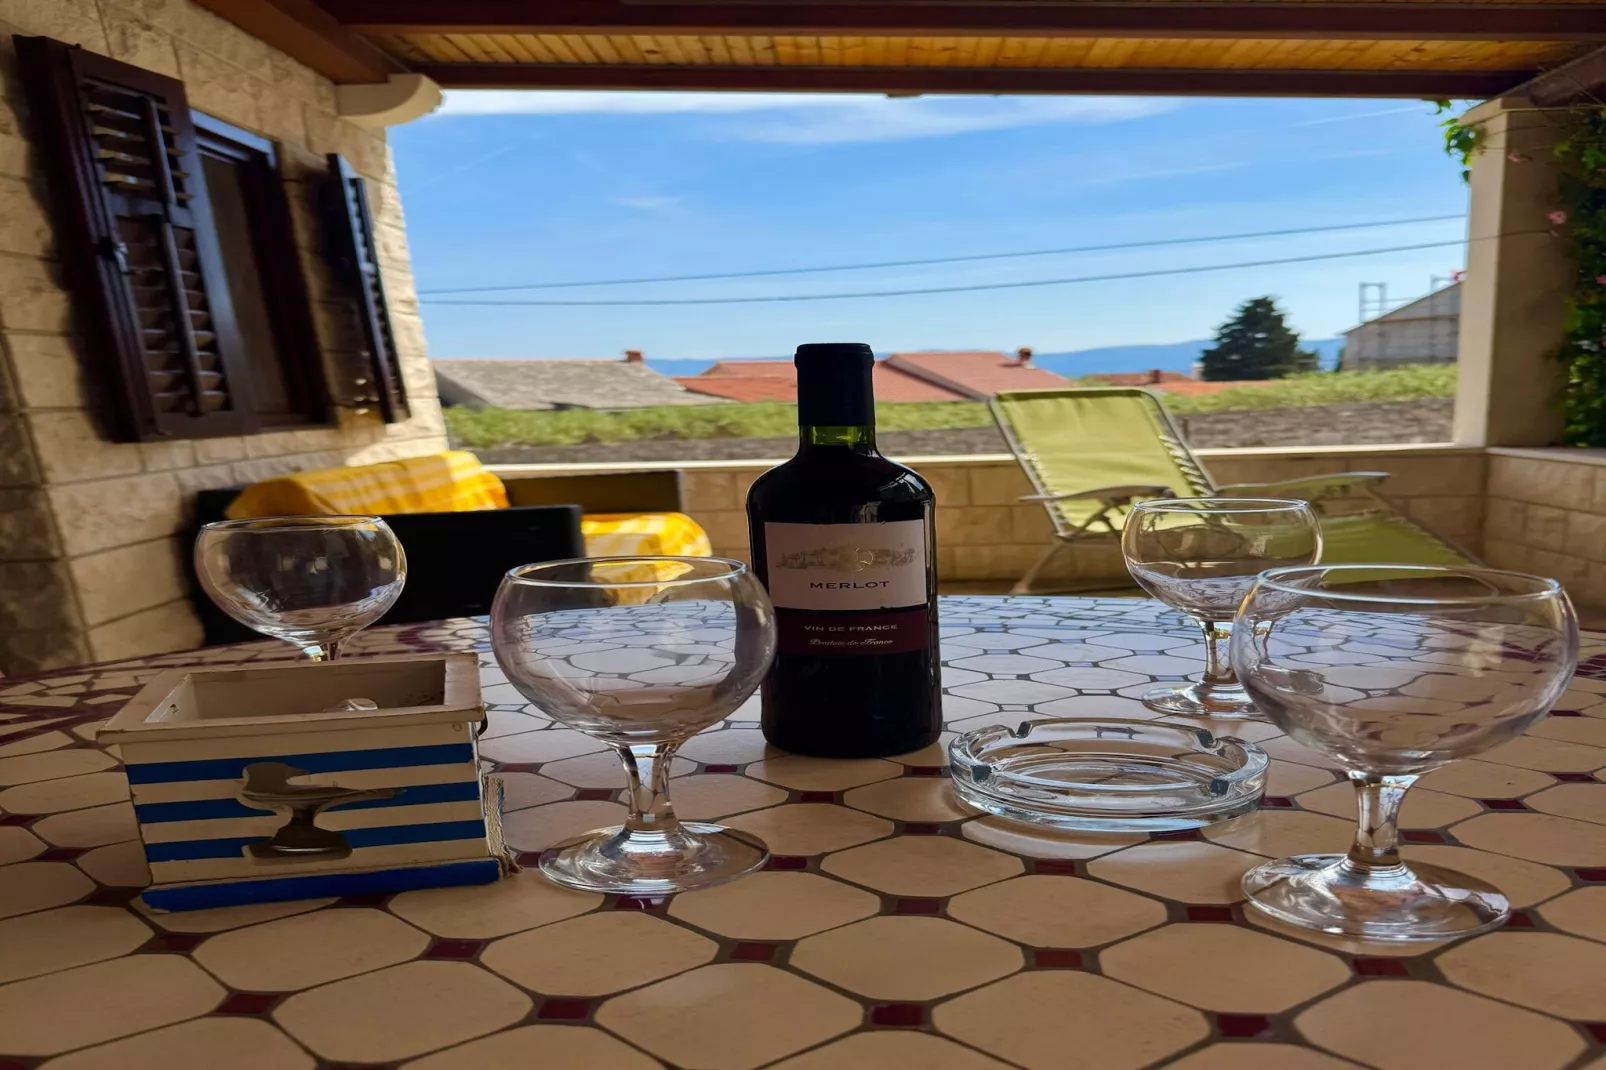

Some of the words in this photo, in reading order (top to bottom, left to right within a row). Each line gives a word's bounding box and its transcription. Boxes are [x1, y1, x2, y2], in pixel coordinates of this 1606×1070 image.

[809, 581, 890, 589] MERLOT
[849, 624, 898, 632] FRANCE
[846, 638, 859, 646] de
[860, 637, 894, 645] France
